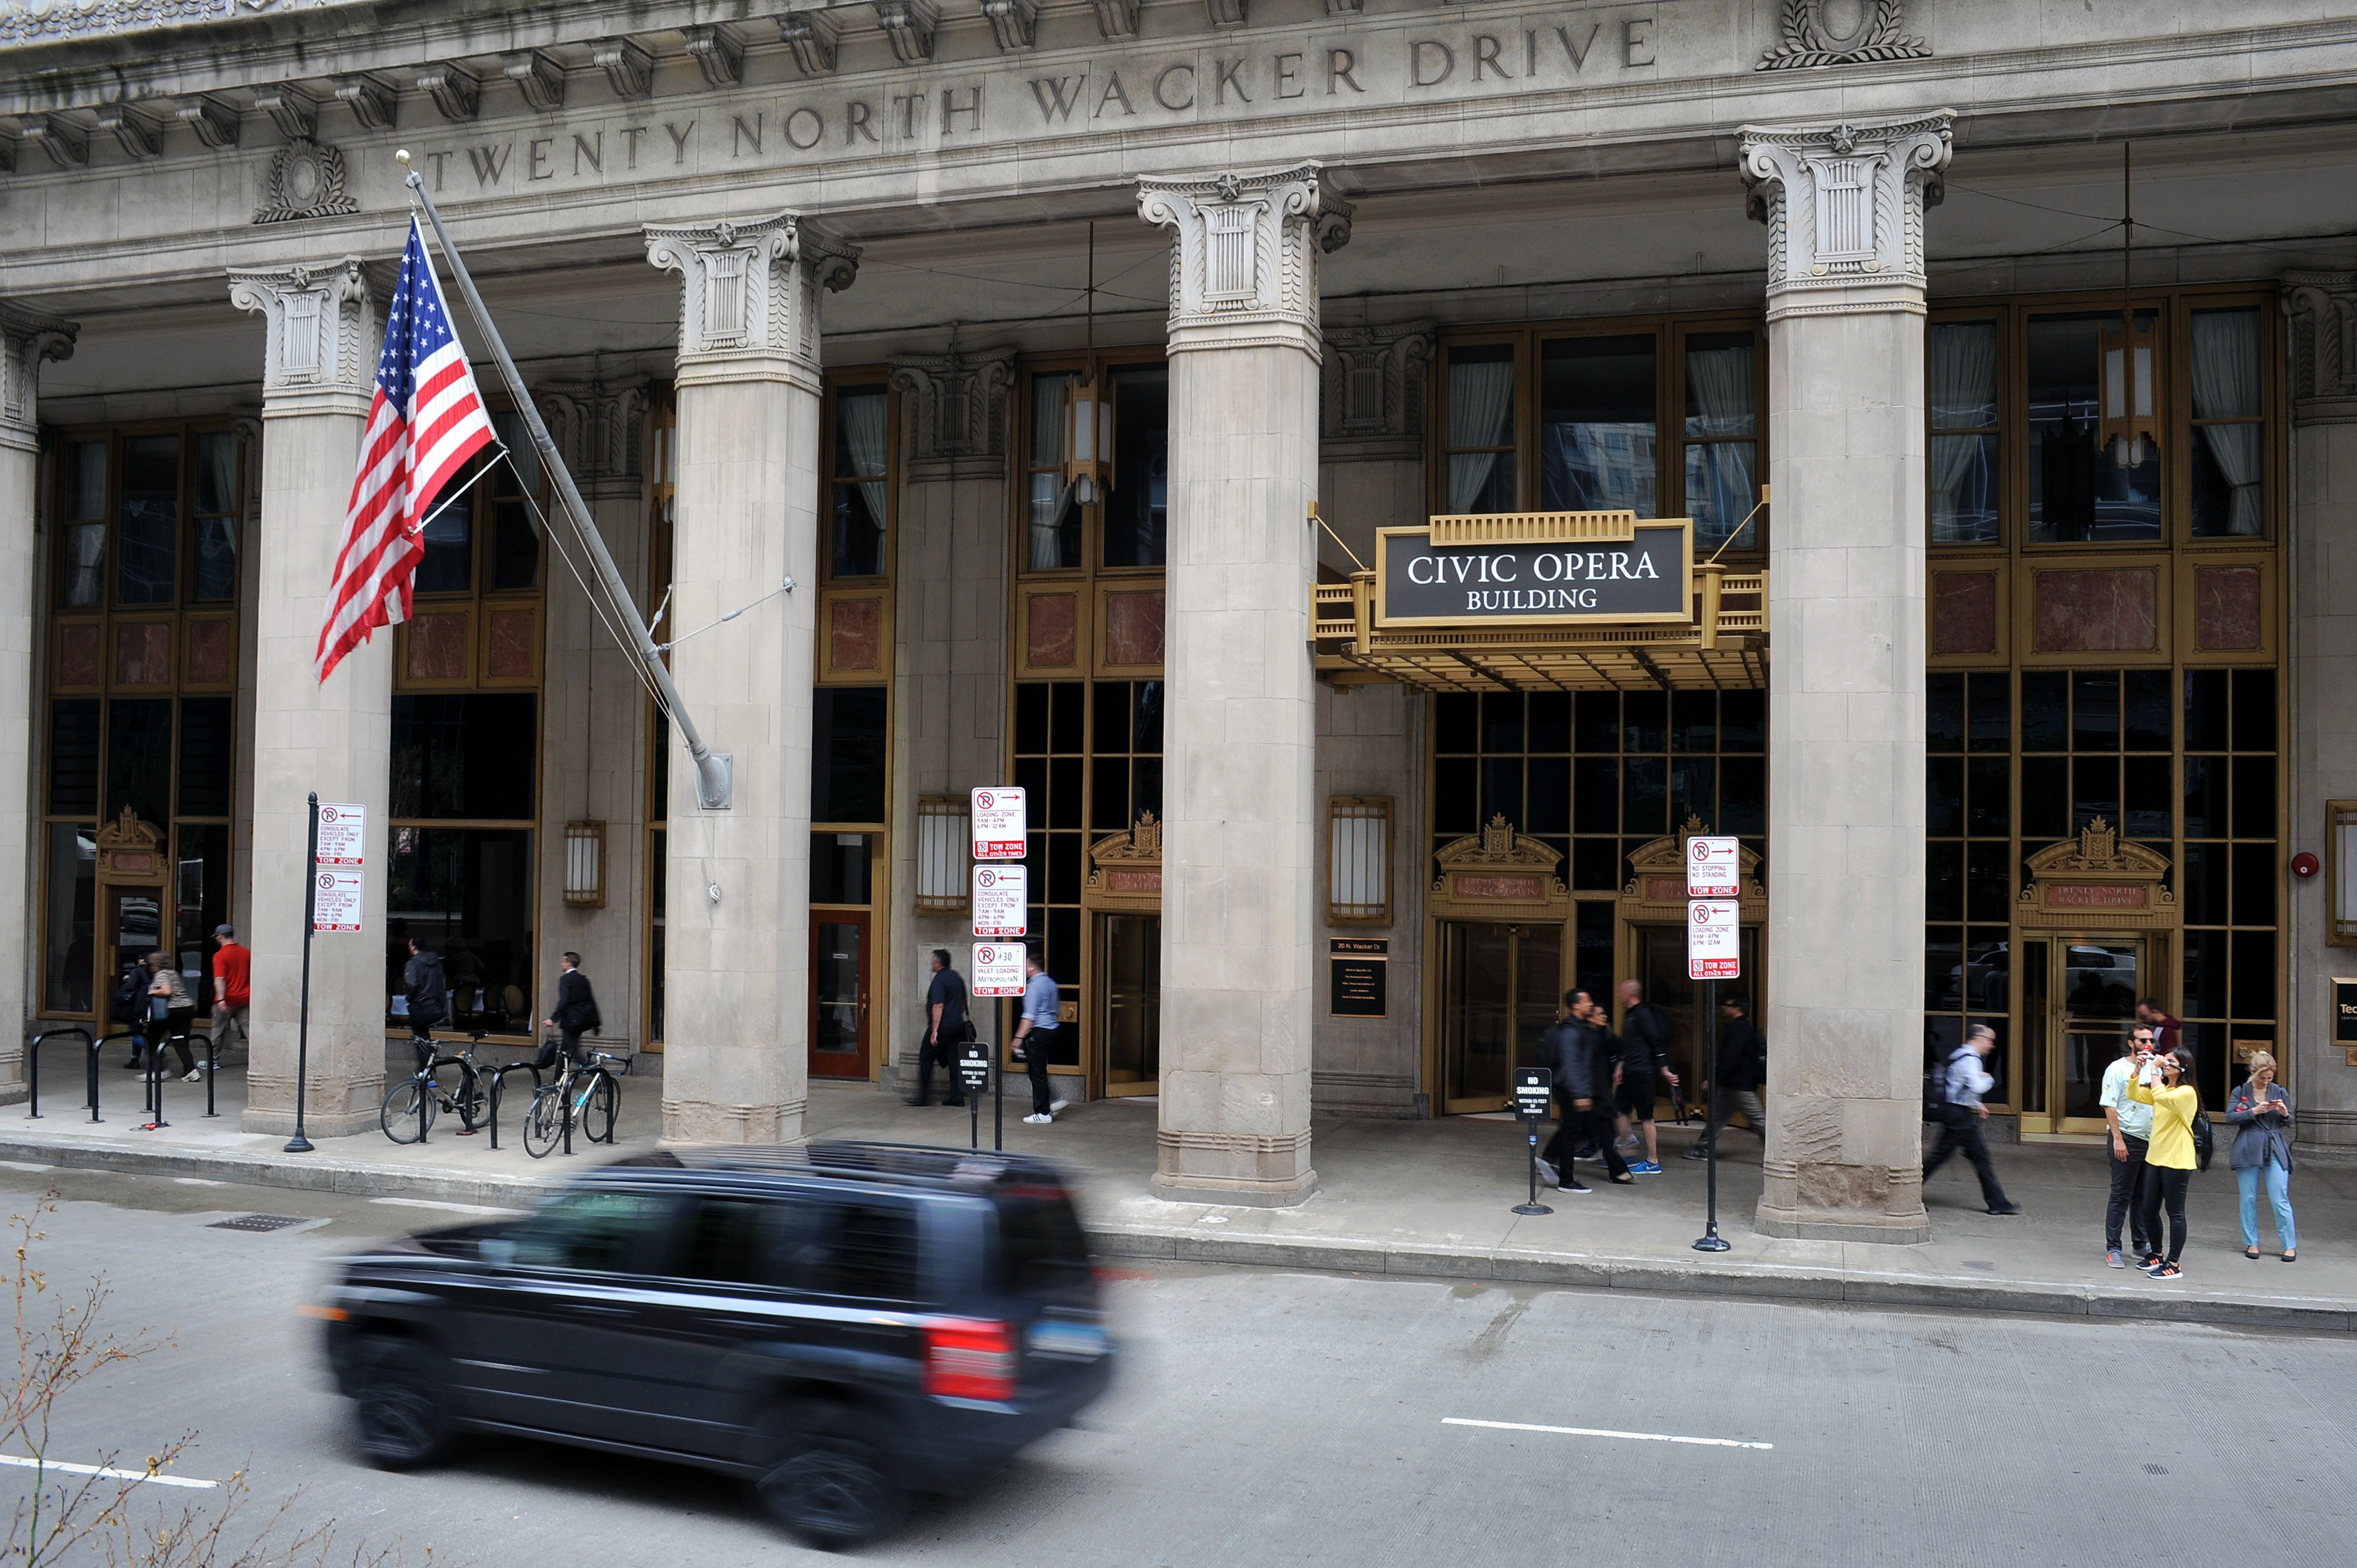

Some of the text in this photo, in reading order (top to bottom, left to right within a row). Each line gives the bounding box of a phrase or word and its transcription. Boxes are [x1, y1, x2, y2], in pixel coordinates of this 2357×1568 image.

[427, 18, 1657, 193] TWENTY NORTH WACKER DRIVE
[1408, 551, 1660, 585] CIVIC OPERA
[1466, 588, 1598, 610] BUILDING
[1003, 952, 1012, 961] 30
[969, 1050, 978, 1058] NO
[959, 1059, 988, 1068] SMOKING
[1527, 1076, 1538, 1085] NO
[1516, 1086, 1549, 1095] SMOKING
